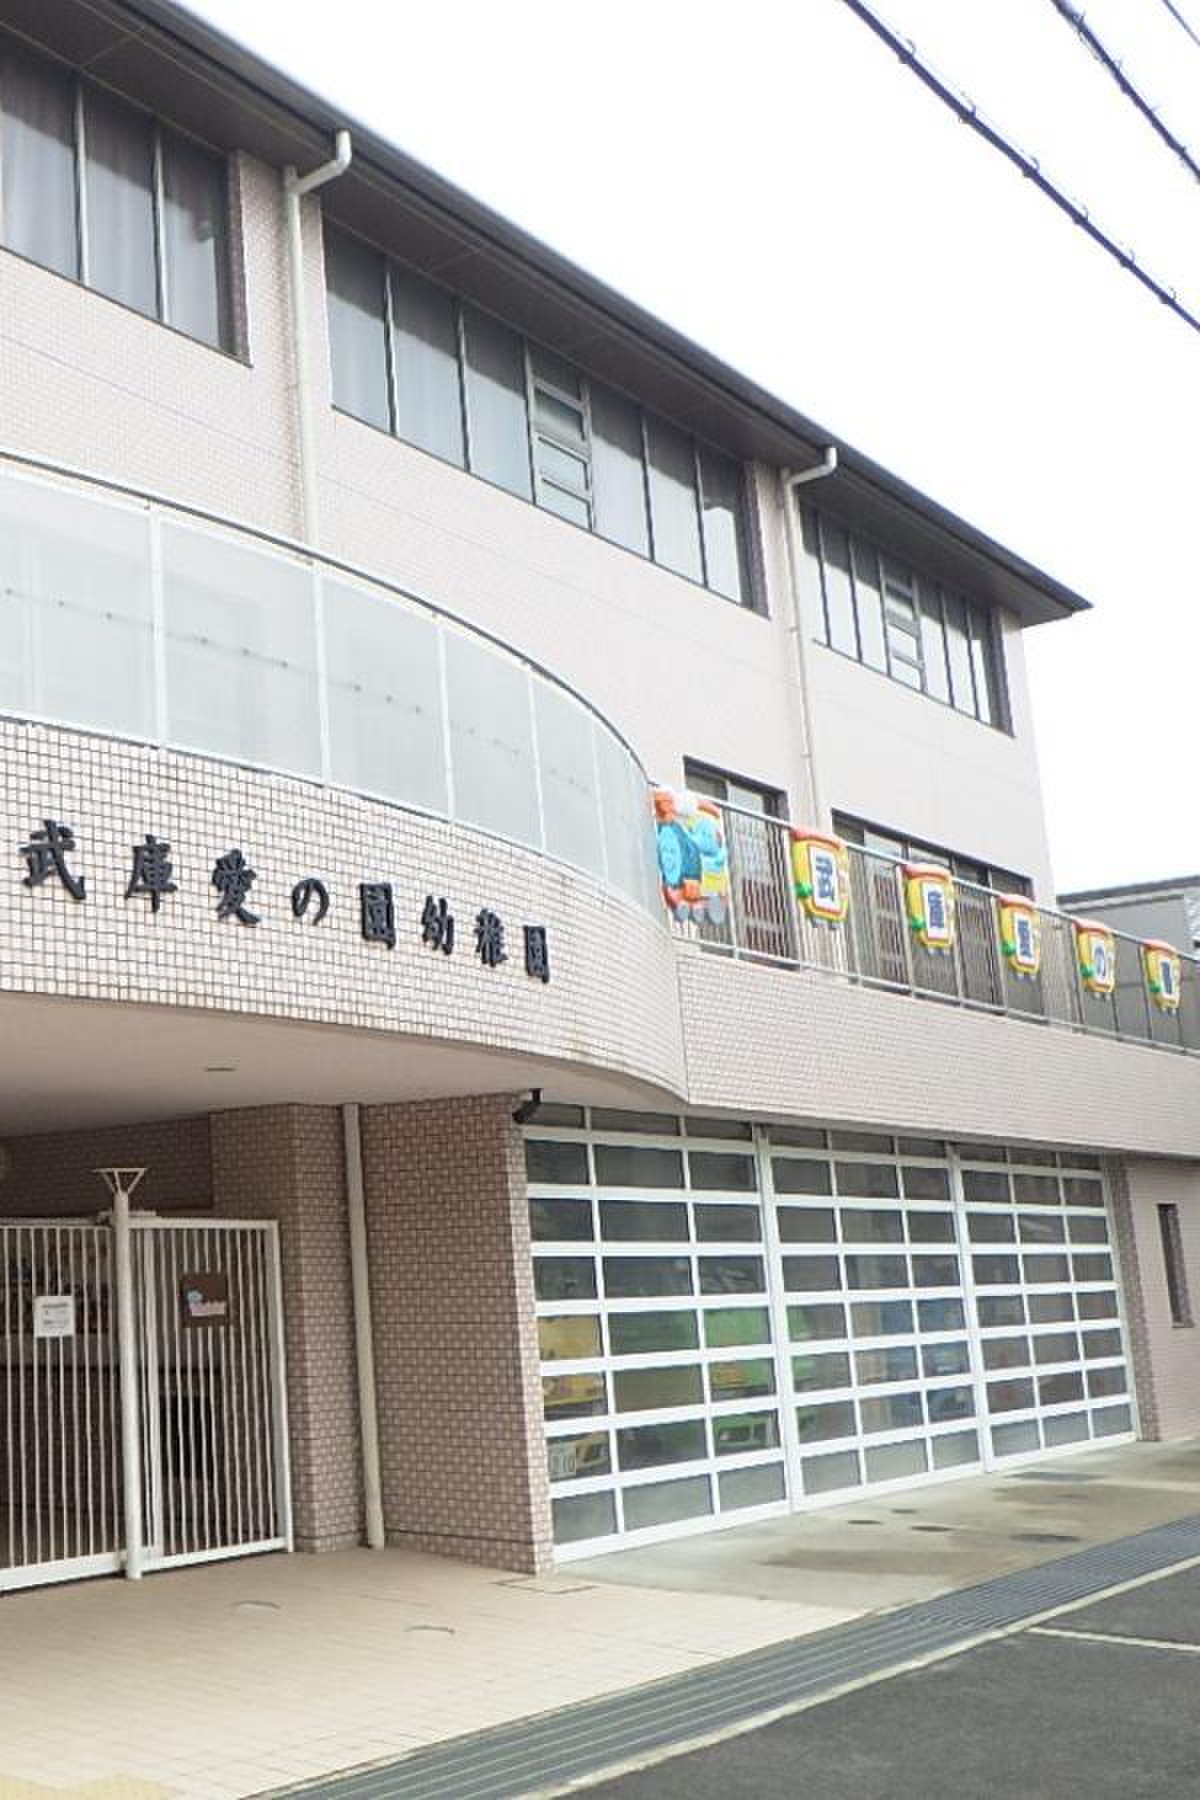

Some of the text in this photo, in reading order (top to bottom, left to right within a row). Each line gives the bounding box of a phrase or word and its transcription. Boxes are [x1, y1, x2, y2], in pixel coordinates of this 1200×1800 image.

[20, 819, 550, 984] 武庫愛の園幼稚園
